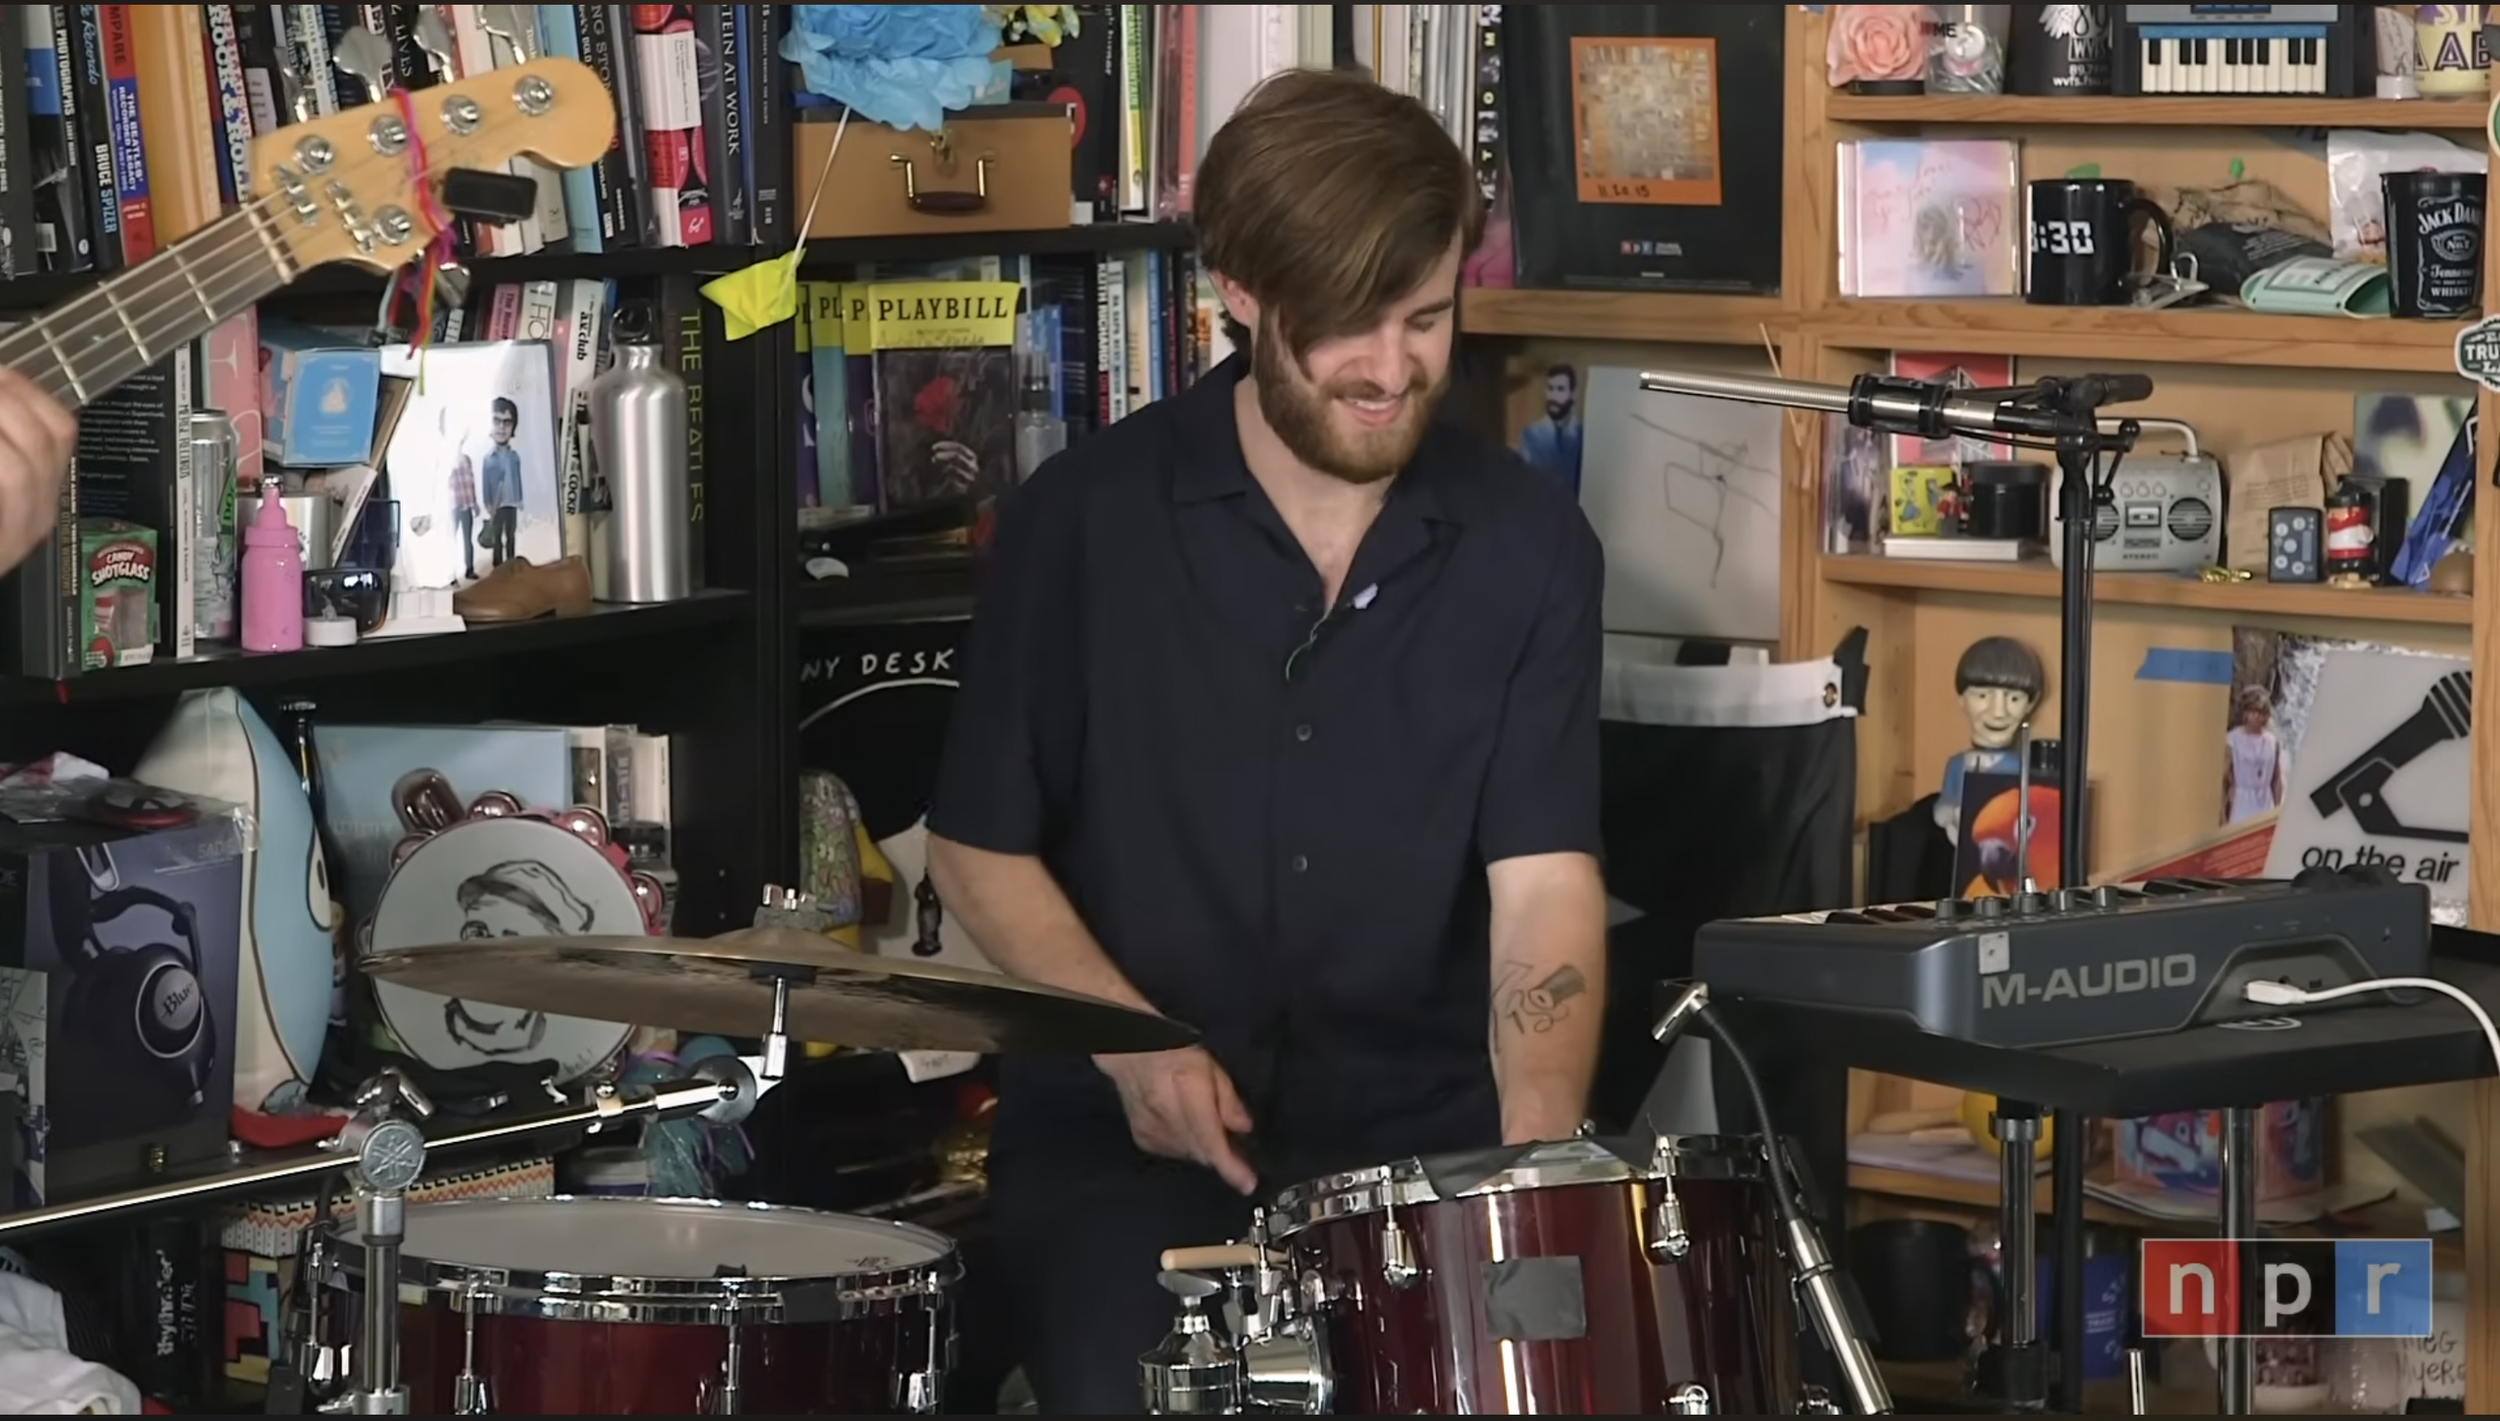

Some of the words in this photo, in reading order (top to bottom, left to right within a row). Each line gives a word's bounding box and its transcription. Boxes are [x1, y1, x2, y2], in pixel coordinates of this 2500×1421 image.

[207, 5, 236, 92] ROCK
[305, 6, 317, 43] GUITAR
[312, 47, 325, 81] WORLD
[395, 25, 414, 77] LIVES
[56, 29, 75, 116] PHOTOGRAPHS
[723, 62, 737, 86] AT
[127, 93, 137, 118] THE
[726, 91, 740, 156] WORK
[118, 86, 132, 147] RECORDED
[125, 148, 137, 191] LEGACY
[130, 121, 144, 182] BEATLES'
[95, 144, 112, 187] BRUCE
[101, 189, 117, 234] SPIZER
[2417, 207, 2454, 235] JACK
[878, 296, 1009, 323] PLAYBILL
[576, 331, 590, 361] club
[679, 308, 701, 372] THE
[1097, 305, 1110, 372] RICHARDS
[177, 403, 191, 436] MERGE
[91, 561, 152, 588] SHOTGLASS
[860, 647, 955, 676] DESK
[2301, 845, 2342, 871] on
[2355, 844, 2406, 877] the
[2414, 851, 2460, 883] air
[1982, 952, 2197, 1010] M-AUDIO
